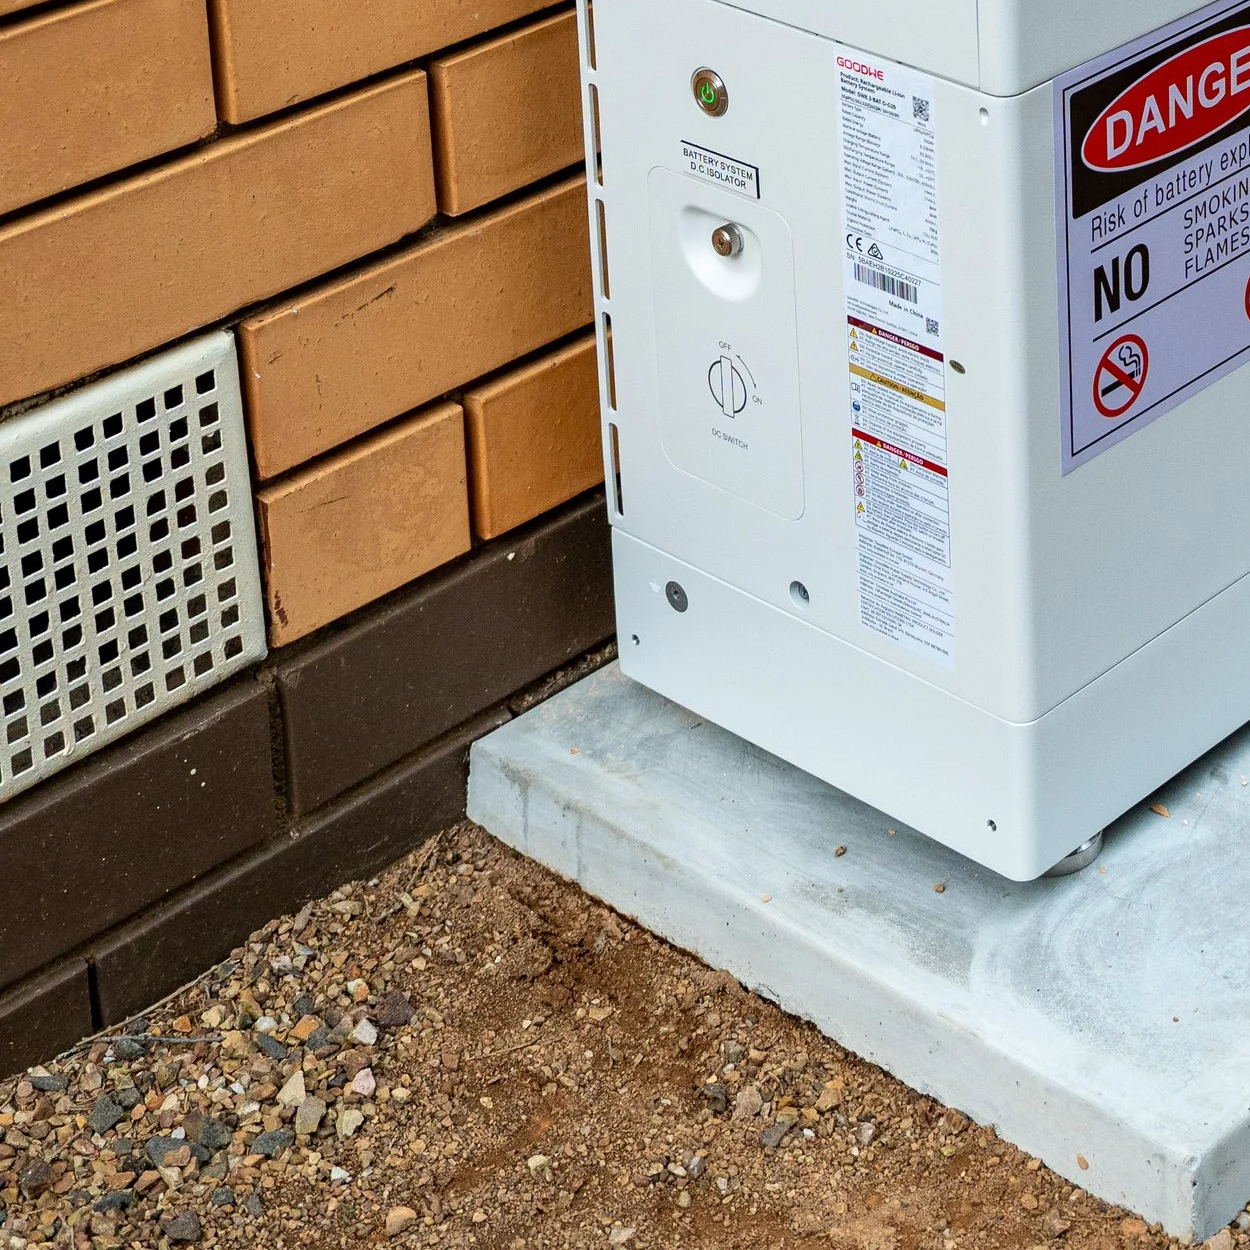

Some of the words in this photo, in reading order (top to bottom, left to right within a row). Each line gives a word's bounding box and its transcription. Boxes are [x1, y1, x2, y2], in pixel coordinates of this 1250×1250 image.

[837, 56, 884, 81] GOODWE
[683, 147, 719, 168] BATTERY
[720, 160, 753, 181] SYSTEM
[1092, 203, 1126, 243] Risk
[1133, 190, 1149, 218] of
[1156, 159, 1214, 207] battery
[1184, 203, 1250, 255] SPARKS
[1184, 227, 1250, 279] FLAMES
[1093, 243, 1150, 323] NO
[889, 300, 902, 310] Made
[910, 308, 923, 319] China
[718, 341, 732, 351] OFF
[752, 395, 763, 405] ON
[711, 428, 722, 438] DC
[722, 432, 749, 450] SWITCH
